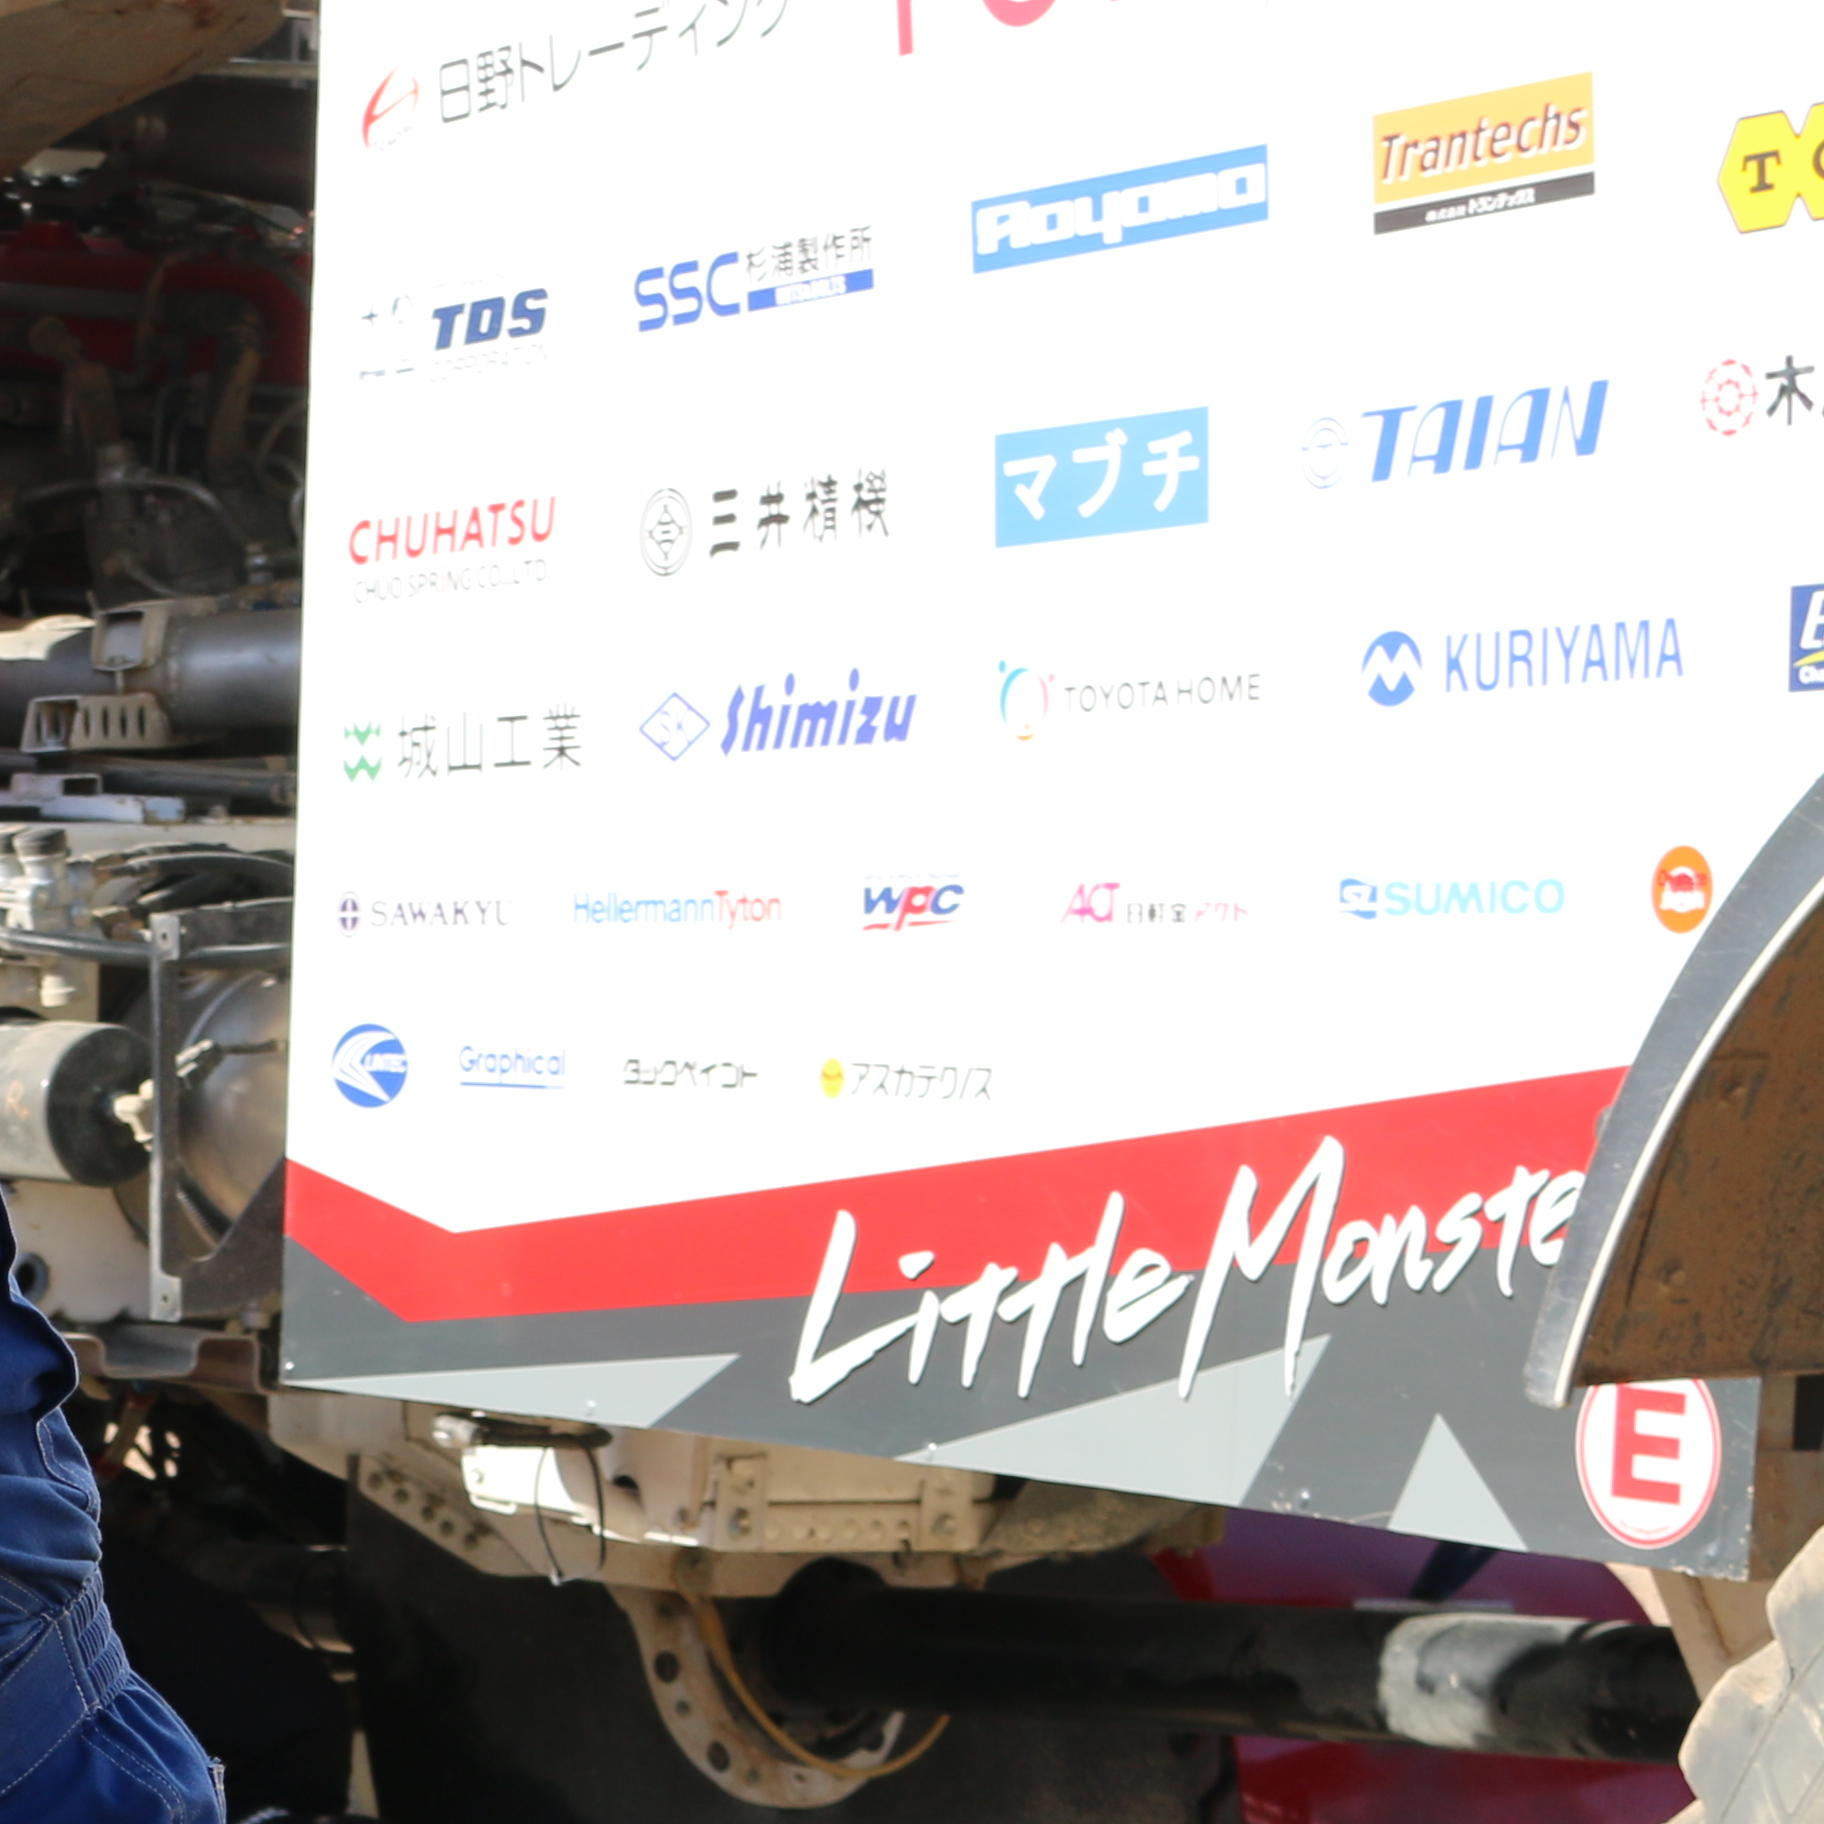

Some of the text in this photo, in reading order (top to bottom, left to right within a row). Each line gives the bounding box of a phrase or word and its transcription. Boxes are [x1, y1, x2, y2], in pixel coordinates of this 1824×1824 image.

[1380, 102, 1588, 184] Trantechs
[633, 252, 741, 333] SSC
[745, 225, 873, 284] 杉浦製作所
[431, 287, 549, 352] TDS
[1361, 379, 1610, 483] TAIAN
[1003, 427, 1201, 521] マブチ
[348, 496, 556, 566] CHUHATSU
[708, 467, 890, 559] 三井精機
[1064, 673, 1262, 714] TOYOTA HOME
[1444, 617, 1686, 693] KURIYAMA
[397, 702, 582, 780] 城山工業
[719, 667, 918, 758] Shimizu
[572, 889, 782, 930] HellermannTyton
[1384, 877, 1567, 917] SUMICO
[458, 1045, 567, 1085] Graphical
[850, 1062, 994, 1101] アスカテクノス
[788, 1191, 1196, 1403] Little
[1610, 1380, 1687, 1506] E
